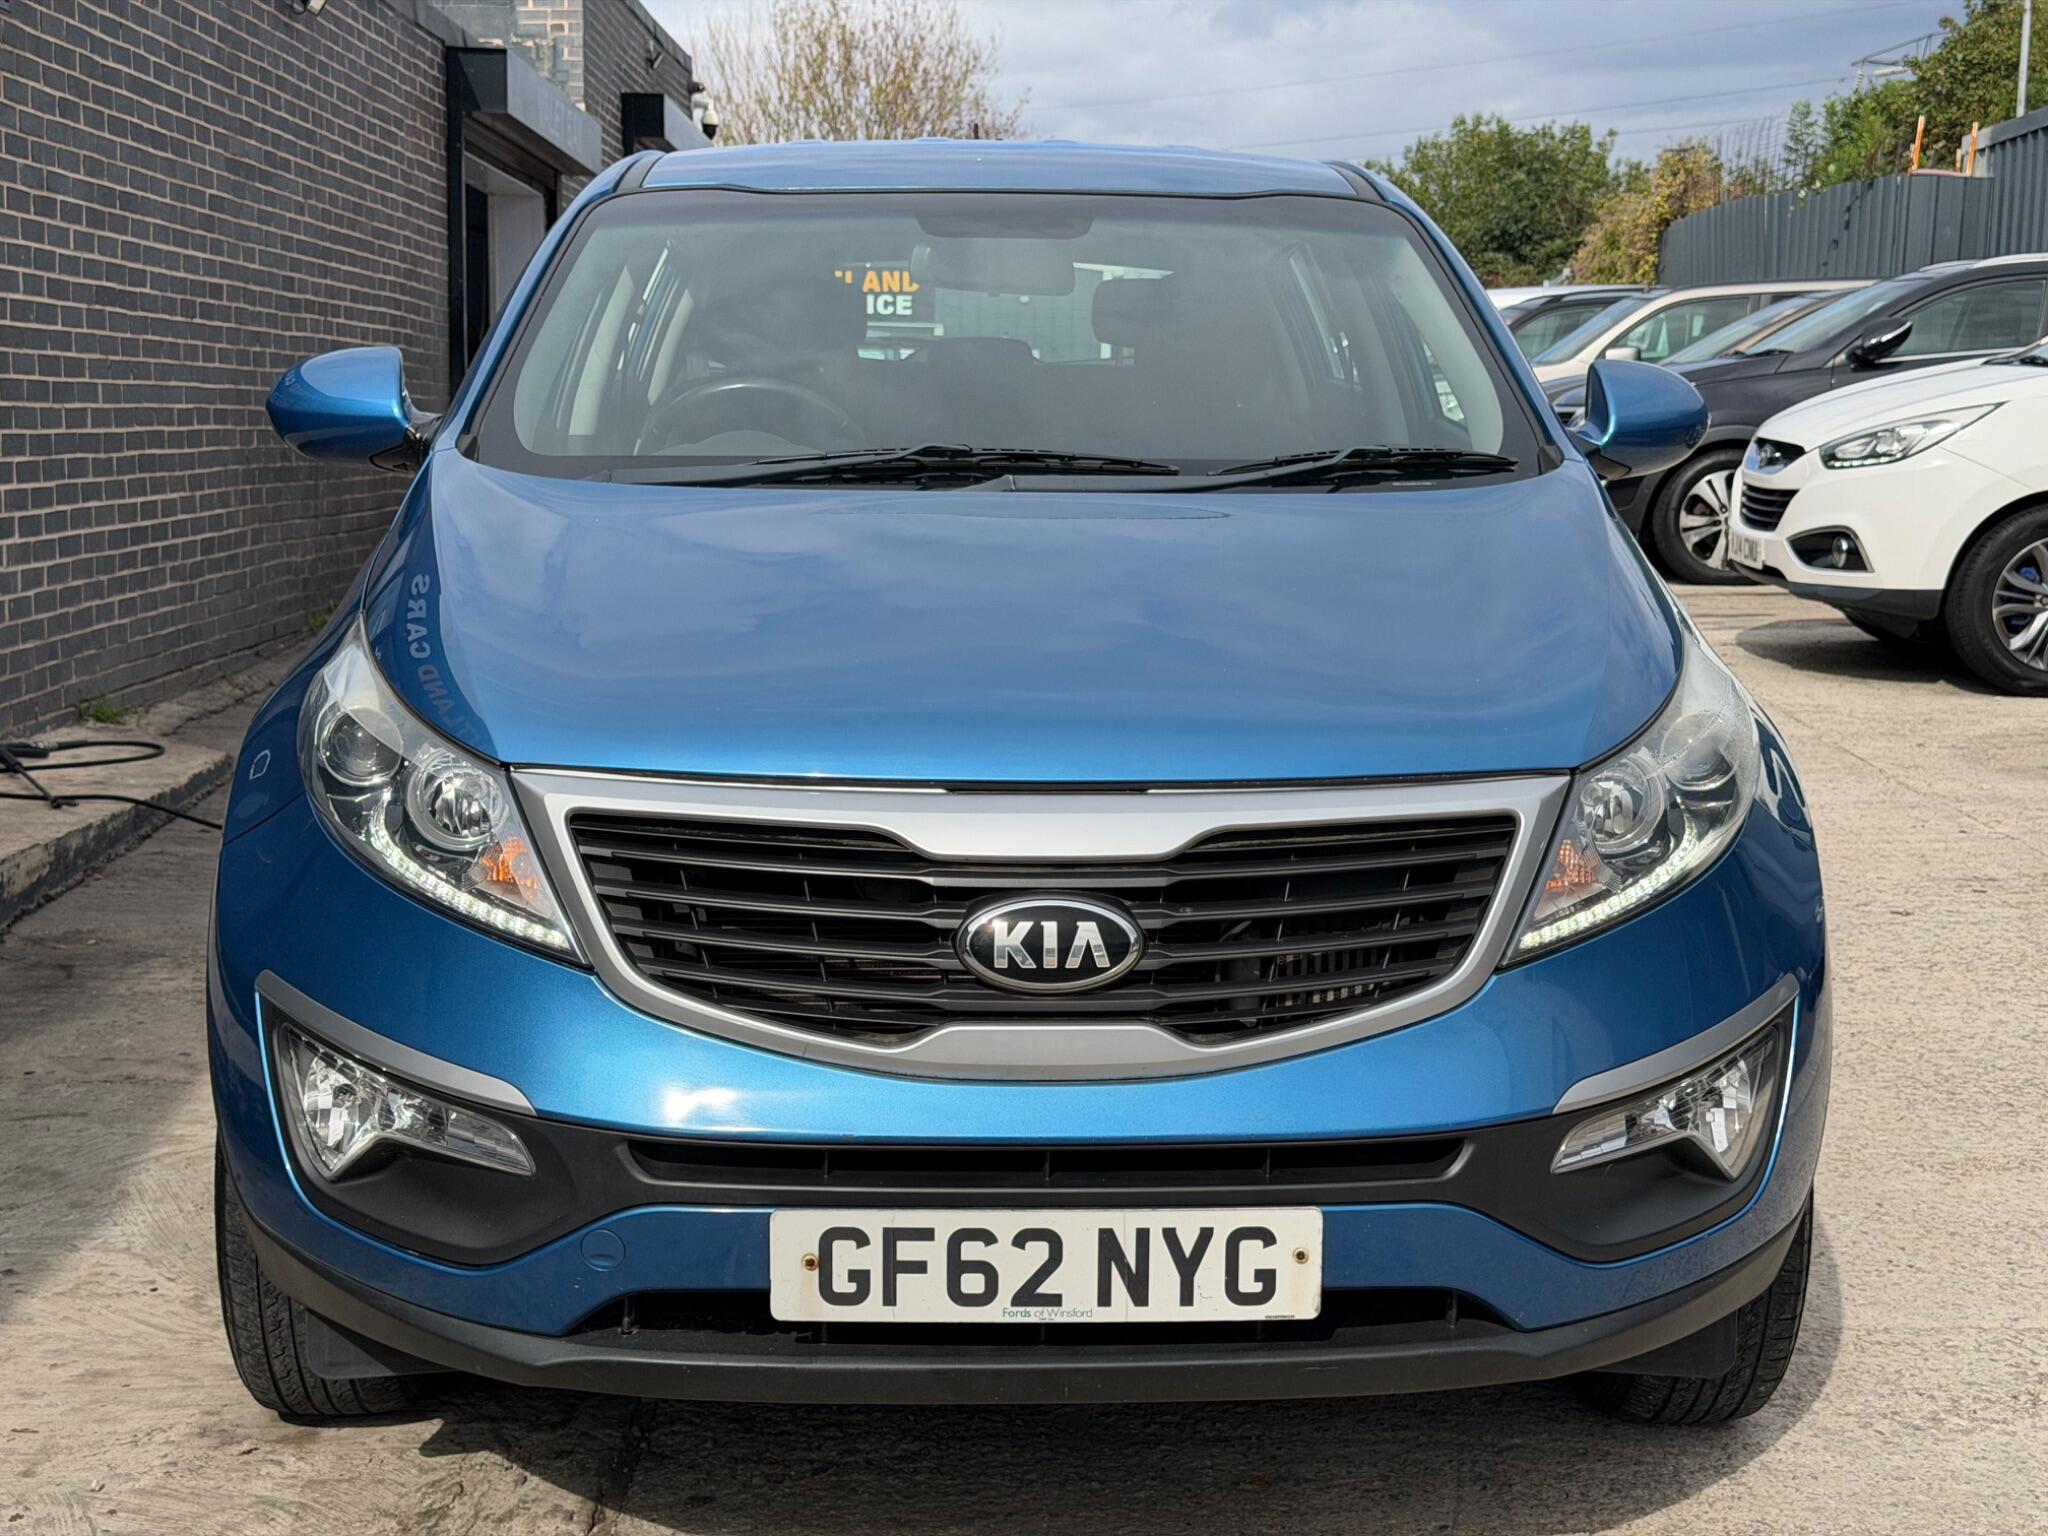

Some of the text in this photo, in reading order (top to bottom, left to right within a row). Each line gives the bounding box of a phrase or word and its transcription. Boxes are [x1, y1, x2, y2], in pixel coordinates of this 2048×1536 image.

[866, 294, 913, 316] ICE
[992, 921, 1111, 969] KIA
[818, 1226, 1278, 1307] GF62 NYG
[1002, 1307, 1093, 1318] Fords of Winsford
